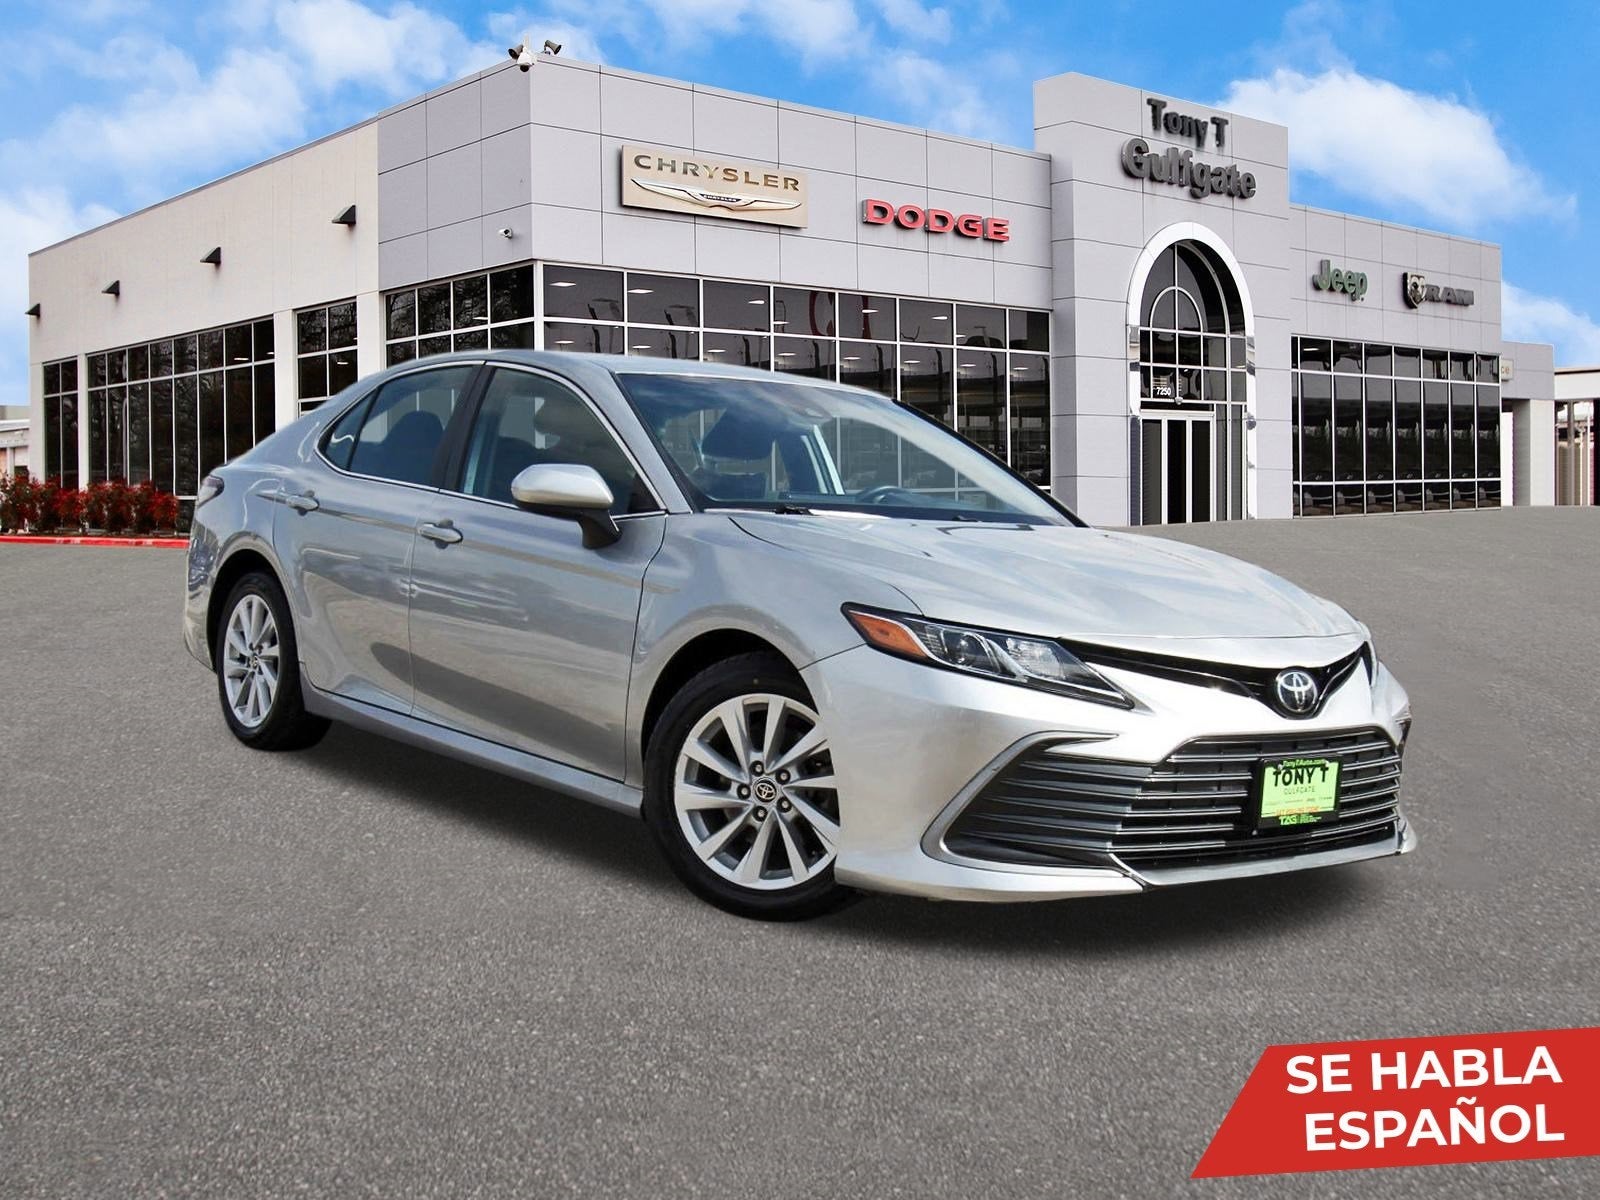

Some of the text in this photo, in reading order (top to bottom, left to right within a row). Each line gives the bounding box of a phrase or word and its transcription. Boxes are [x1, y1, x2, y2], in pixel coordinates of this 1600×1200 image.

[1147, 98, 1229, 147] Tony T
[633, 154, 801, 192] CHRYSLER
[1121, 138, 1257, 199] Gulfgate
[863, 198, 1010, 243] DODGE
[1312, 259, 1368, 302] Jeep
[1425, 284, 1475, 307] RAM
[1273, 765, 1329, 787] TONY T
